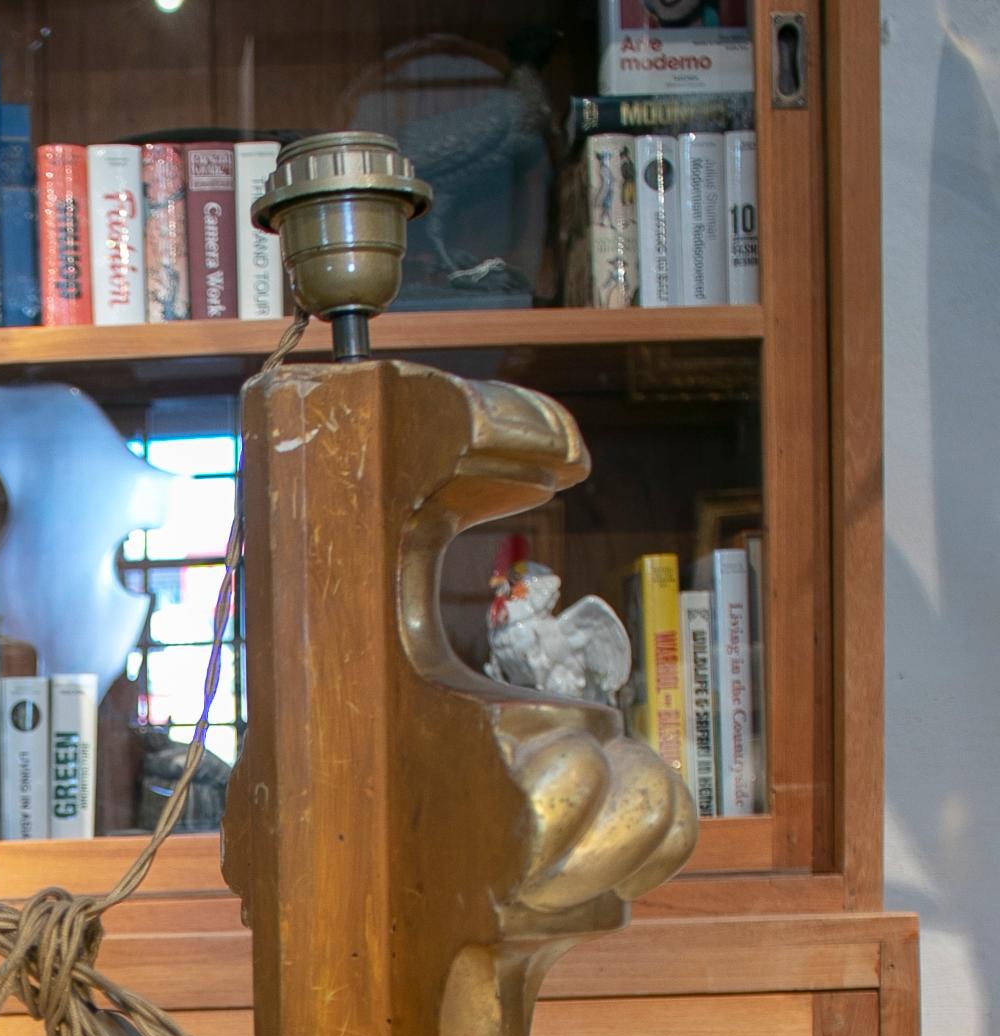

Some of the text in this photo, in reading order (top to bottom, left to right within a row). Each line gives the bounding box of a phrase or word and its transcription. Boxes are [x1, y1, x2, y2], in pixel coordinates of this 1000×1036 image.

[619, 54, 713, 71] moderno
[620, 34, 663, 52] Arte
[203, 201, 222, 269] Camera
[693, 222, 706, 300] Rediscovered
[205, 270, 227, 318] Work
[255, 272, 270, 316] TOUR
[692, 630, 711, 695] WILDLIFE
[725, 602, 749, 808] Living in the Countryside
[696, 711, 712, 758] SAFARI
[19, 750, 31, 793] LIVING
[53, 730, 80, 819] GREEN
[20, 795, 32, 811] IN
